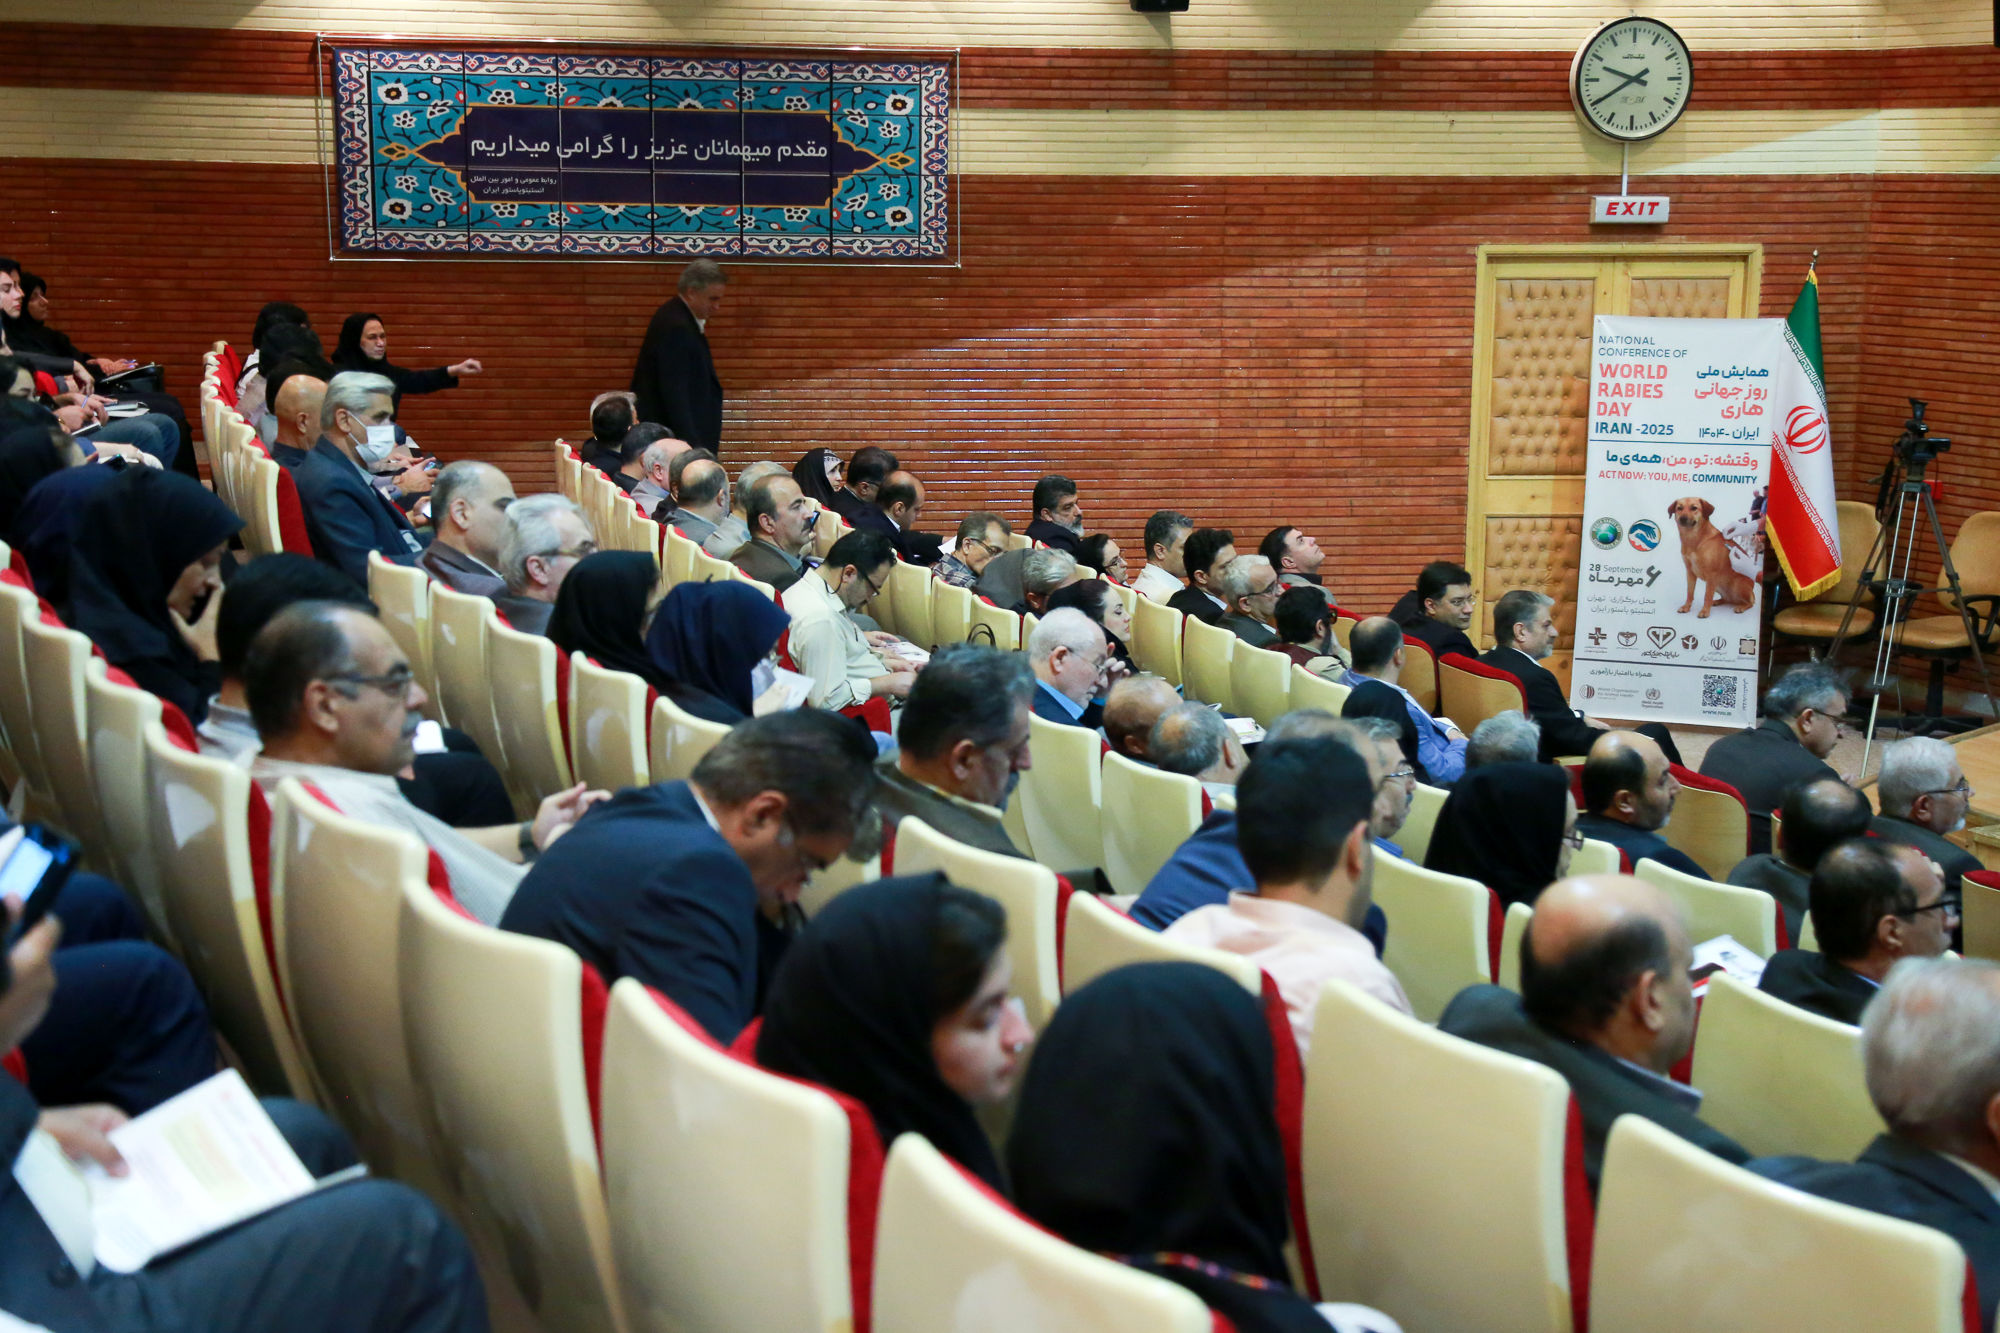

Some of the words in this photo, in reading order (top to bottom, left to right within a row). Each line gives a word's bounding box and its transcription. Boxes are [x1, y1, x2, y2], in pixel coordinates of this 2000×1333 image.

[471, 135, 550, 158] میداریم
[556, 134, 614, 159] گرامی
[622, 137, 638, 160] را
[644, 138, 688, 160] عزیز
[694, 139, 771, 162] میهمانان
[778, 140, 828, 162] مقدم
[1606, 202, 1660, 216] EXIT
[1598, 336, 1656, 345] NATIONAL
[1598, 348, 1670, 358] CONFERENCE
[1672, 350, 1688, 358] OF
[1599, 363, 1668, 380] WORLD
[1696, 366, 1720, 378] ملی
[1722, 365, 1769, 380] همایش
[1598, 382, 1664, 398] RABIES
[1694, 382, 1743, 400] جهانی
[1744, 384, 1768, 400] روز
[1596, 401, 1632, 417] DAY
[1721, 401, 1764, 420] هاری
[1595, 422, 1632, 434] IRAN
[1732, 426, 1760, 440] ایران
[1606, 450, 1618, 462] ما
[1598, 470, 1616, 479] ACT
[1618, 470, 1646, 480] NOW:
[1648, 472, 1670, 482] YOU,
[1672, 472, 1690, 483] ME,
[1692, 473, 1757, 484] COMMUNITY
[1589, 564, 1601, 572] 28
[1603, 564, 1643, 574] September
[1646, 564, 1662, 588] ۶
